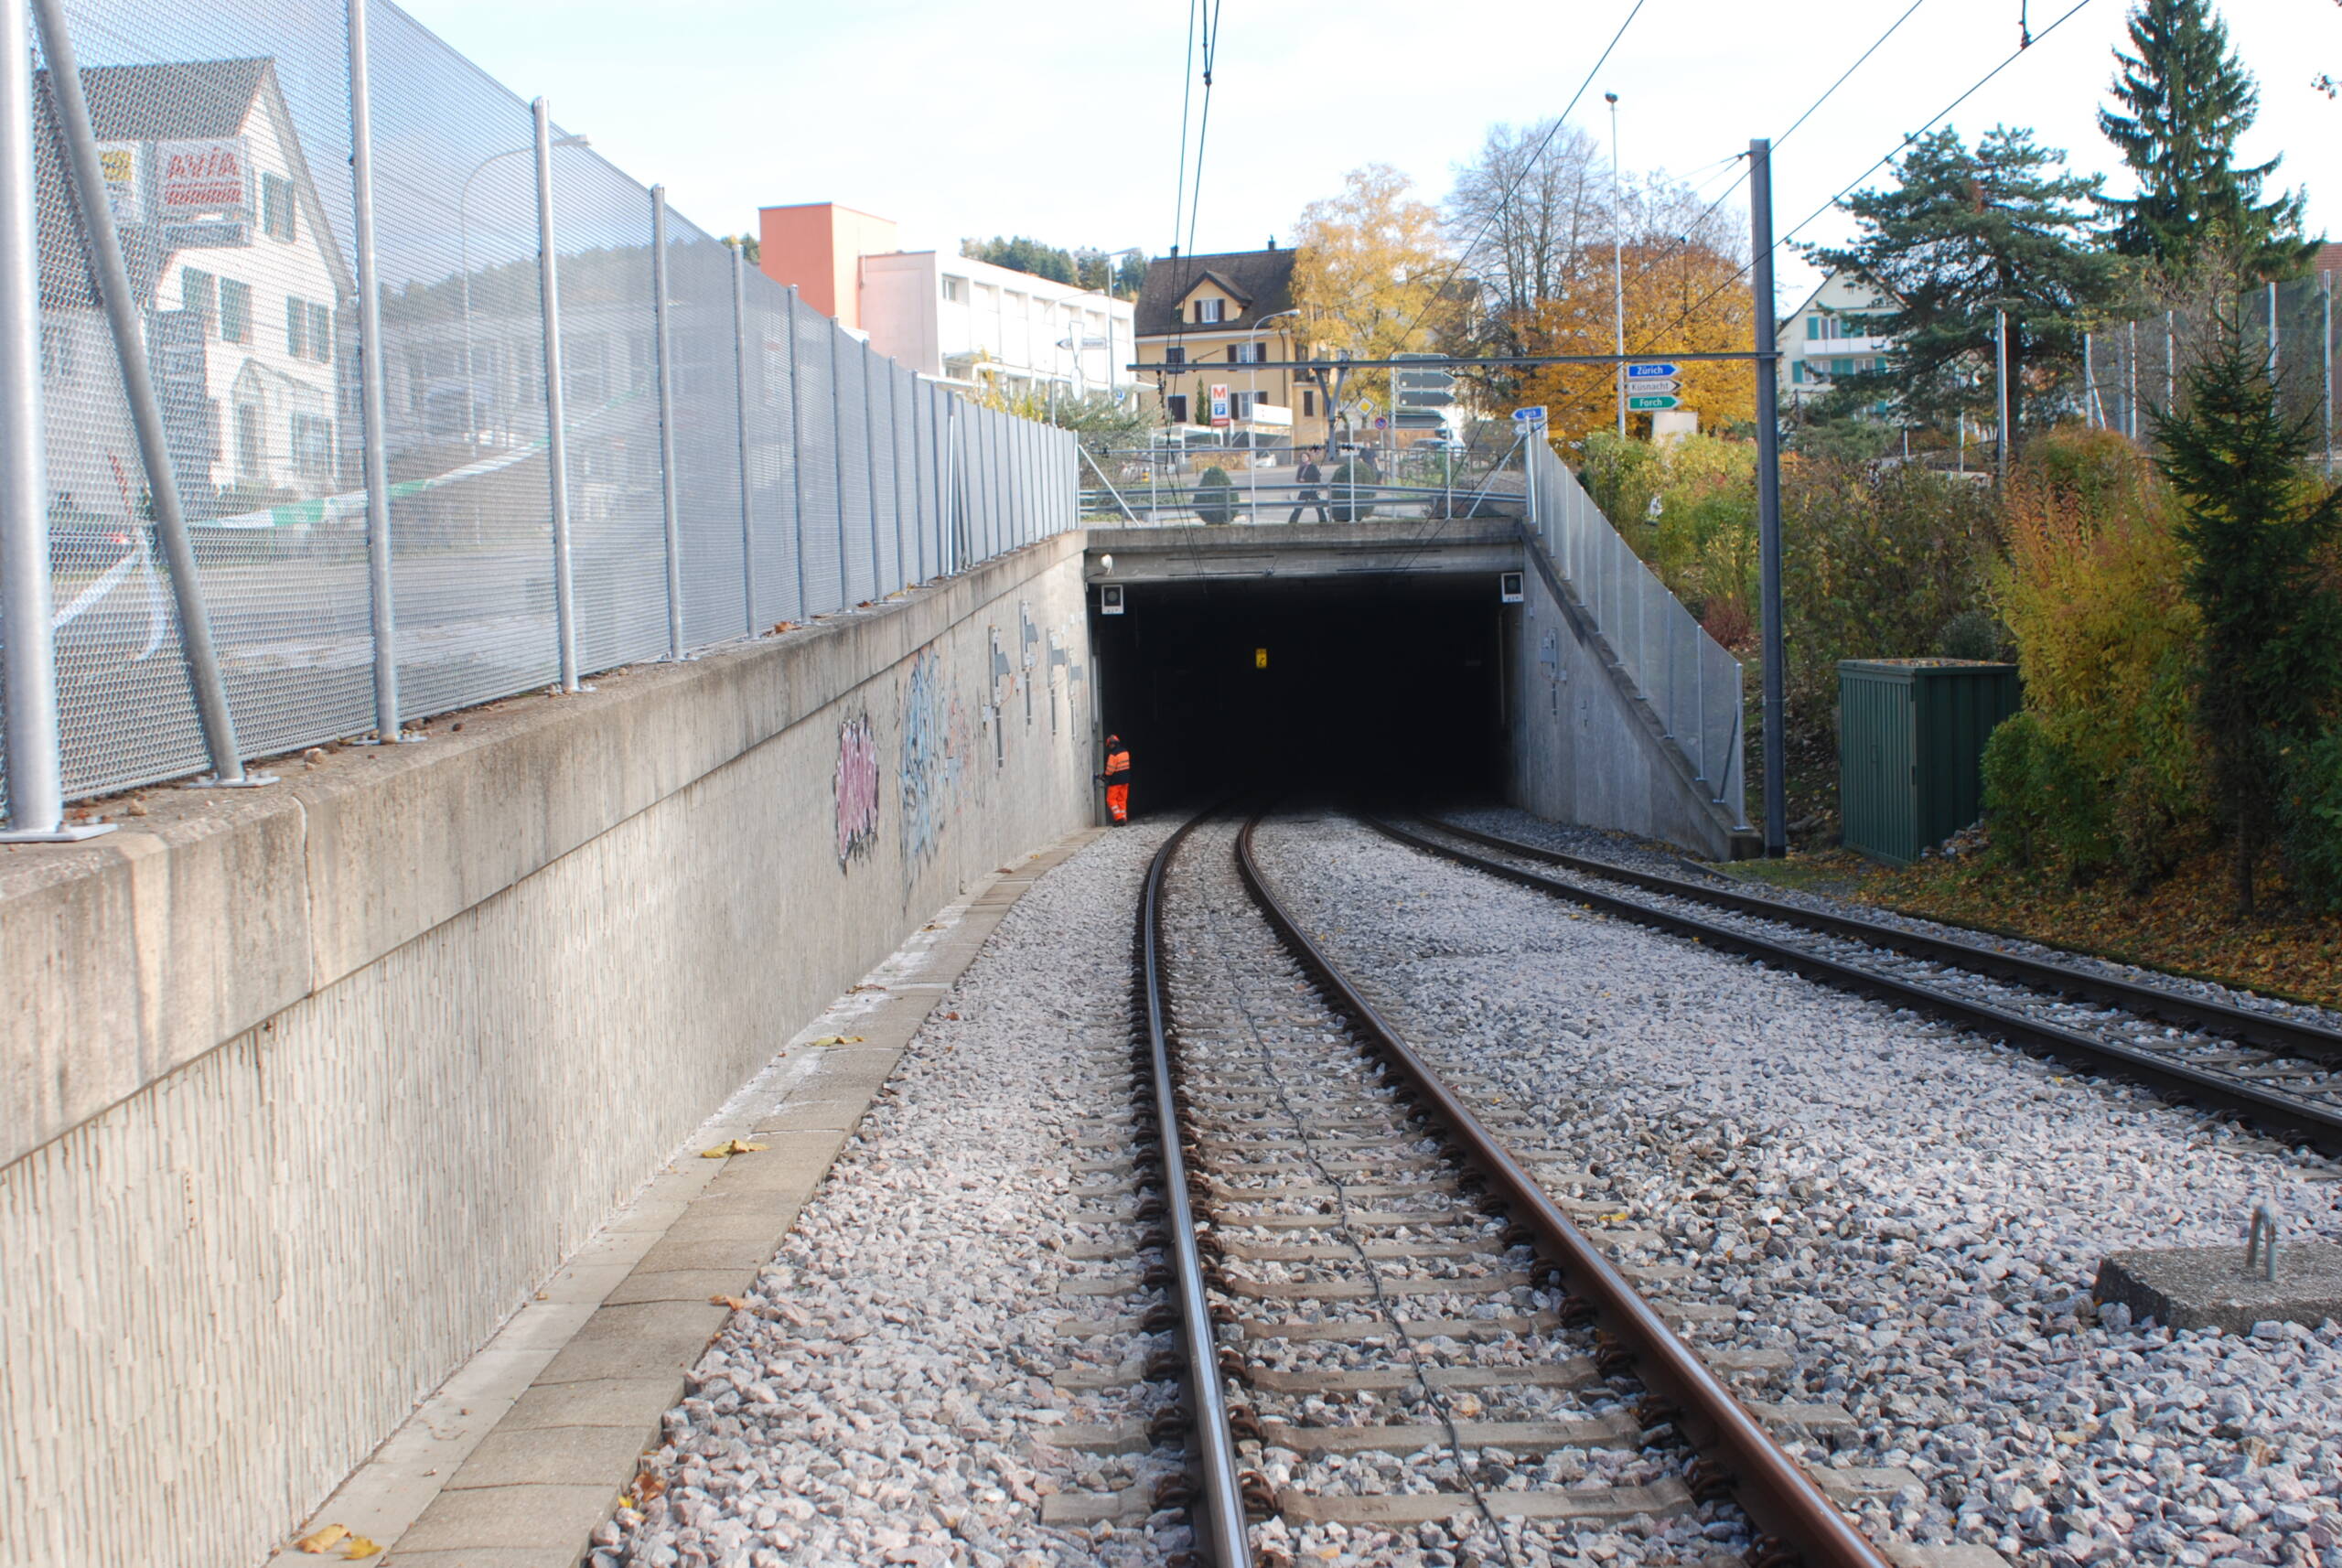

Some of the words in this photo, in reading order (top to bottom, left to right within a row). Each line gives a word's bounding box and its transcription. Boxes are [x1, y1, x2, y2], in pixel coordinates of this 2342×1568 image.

[1637, 365, 1663, 375] Zürich
[1632, 381, 1669, 391] Küsnacht
[1213, 387, 1227, 399] M
[1639, 398, 1662, 407] Forch
